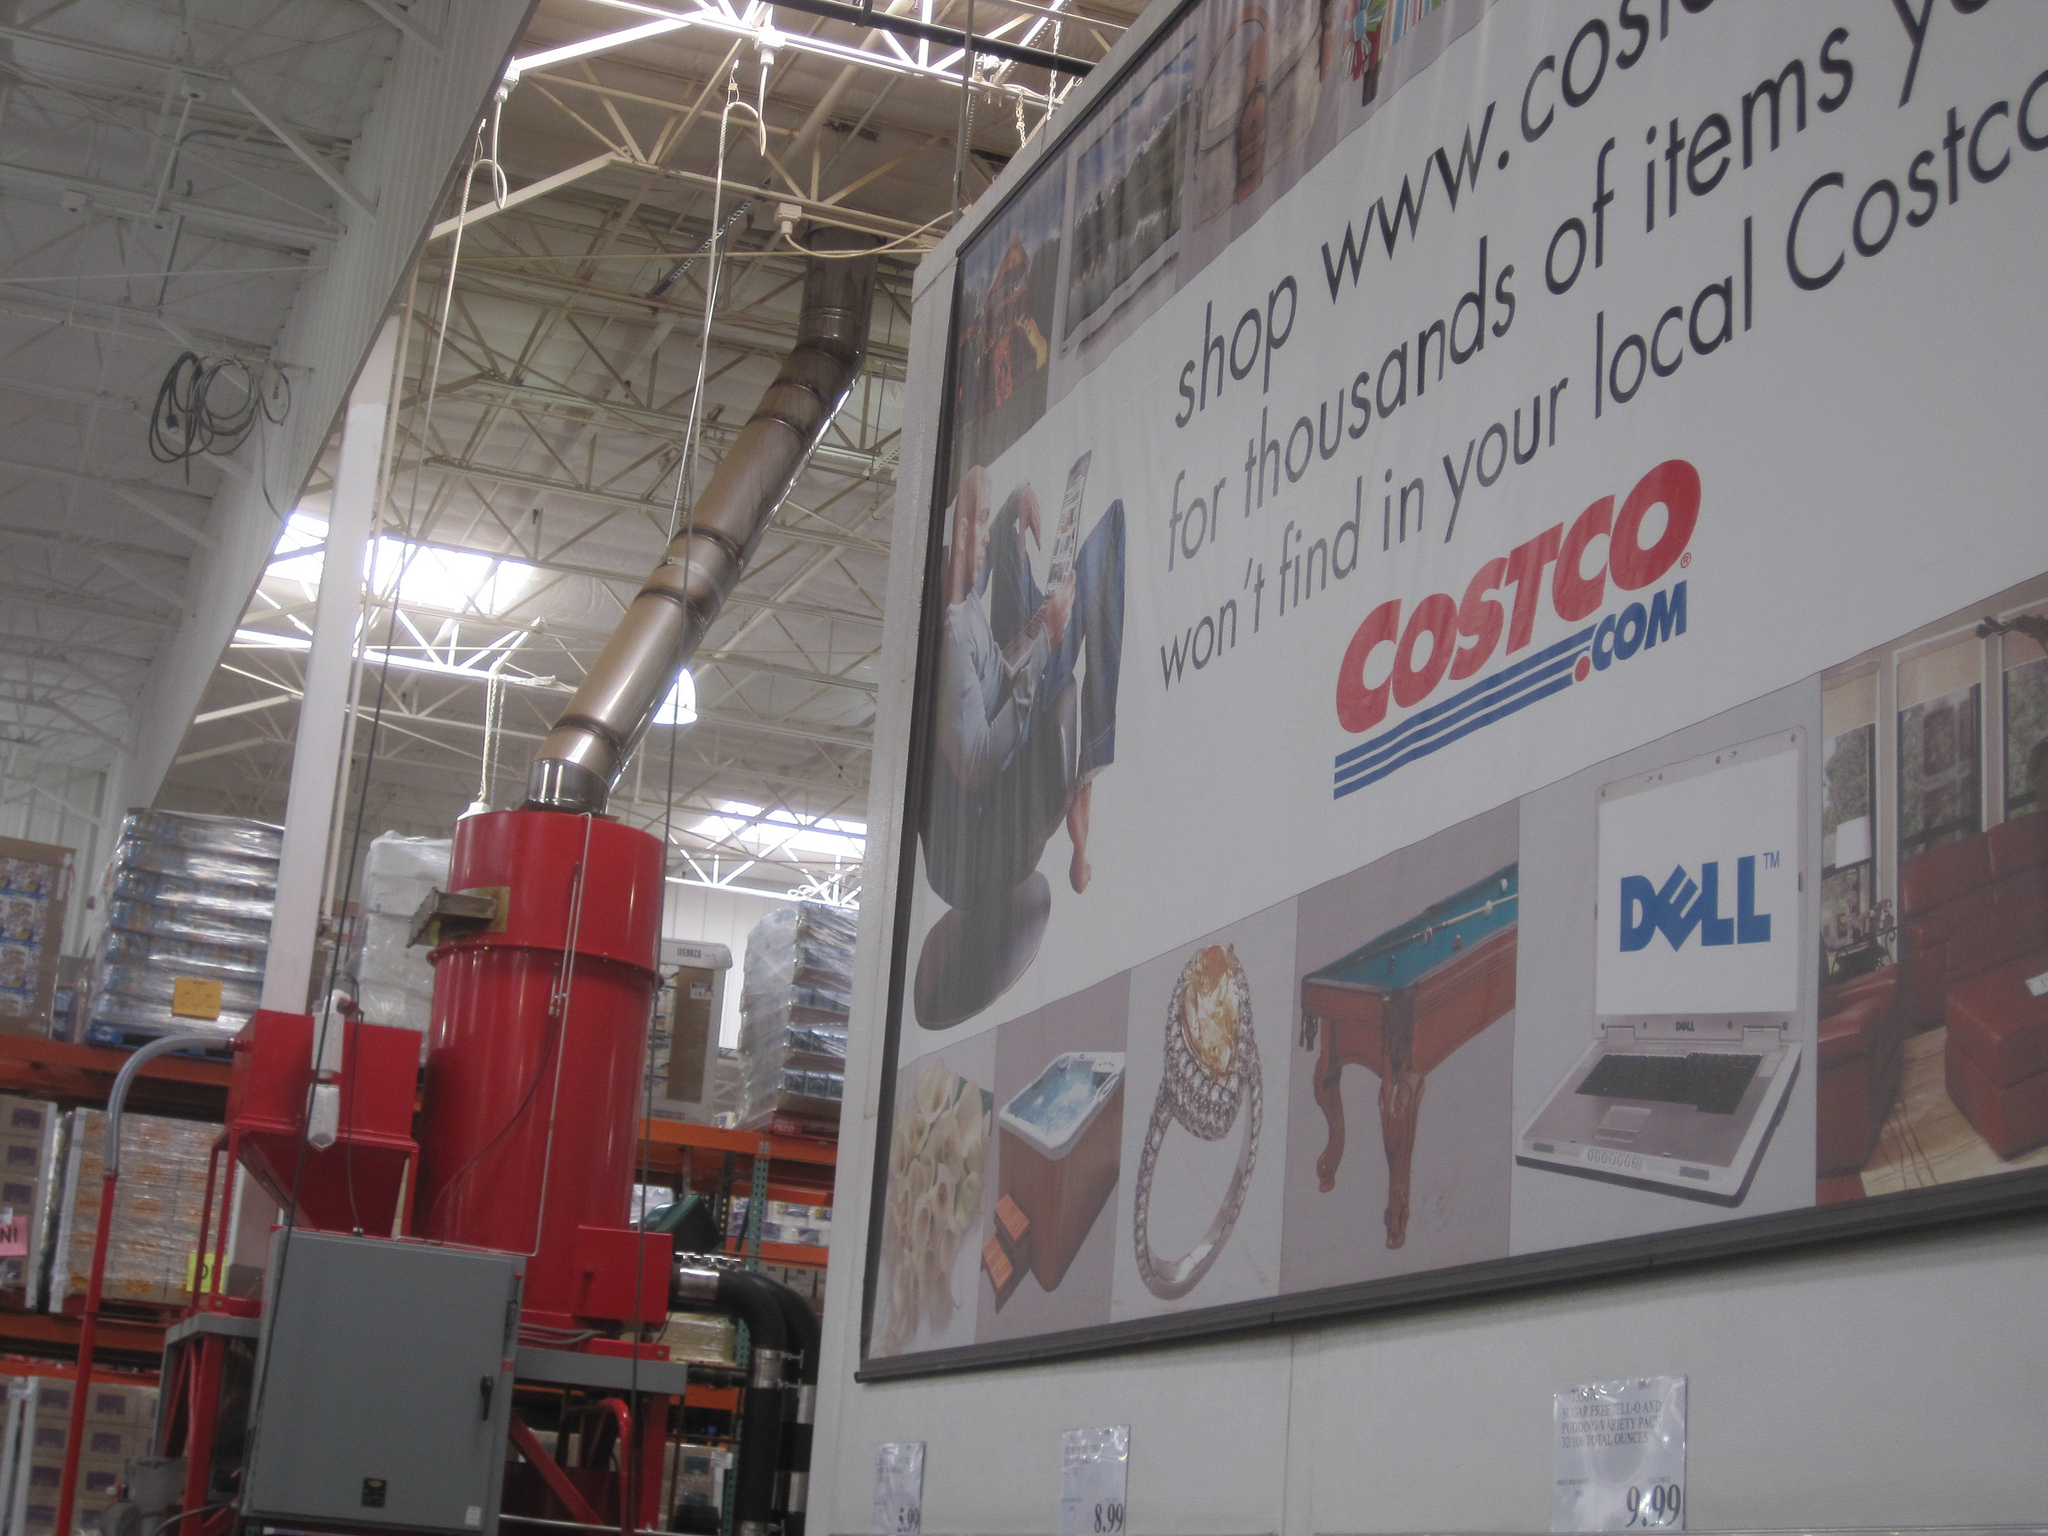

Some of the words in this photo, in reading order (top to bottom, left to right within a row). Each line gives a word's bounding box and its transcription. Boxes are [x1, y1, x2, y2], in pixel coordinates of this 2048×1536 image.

[1174, 275, 1298, 429] shop
[1321, 0, 1715, 306] www.cos
[1168, 469, 1227, 573] for
[1244, 234, 1516, 519] thousands
[1545, 136, 1616, 295] of
[1646, 27, 1854, 235] items
[1160, 557, 1266, 692] won't
[1279, 474, 1363, 617] find
[1383, 468, 1425, 552] in
[1442, 376, 1569, 545] your
[1594, 214, 1753, 420] local
[1335, 458, 1702, 734] COSTCO
[1619, 855, 1772, 953] DELL
[1561, 1419, 1599, 1434] PUDDING
[1600, 1417, 1636, 1431] VARIETY
[1586, 1432, 1613, 1447] TOTAL
[1614, 1430, 1648, 1446] OUNCES
[1590, 1404, 1611, 1417] FREE
[1642, 1400, 1662, 1414] AND
[1094, 1503, 1124, 1534] 8.99
[1626, 1484, 1681, 1528] 9.99
